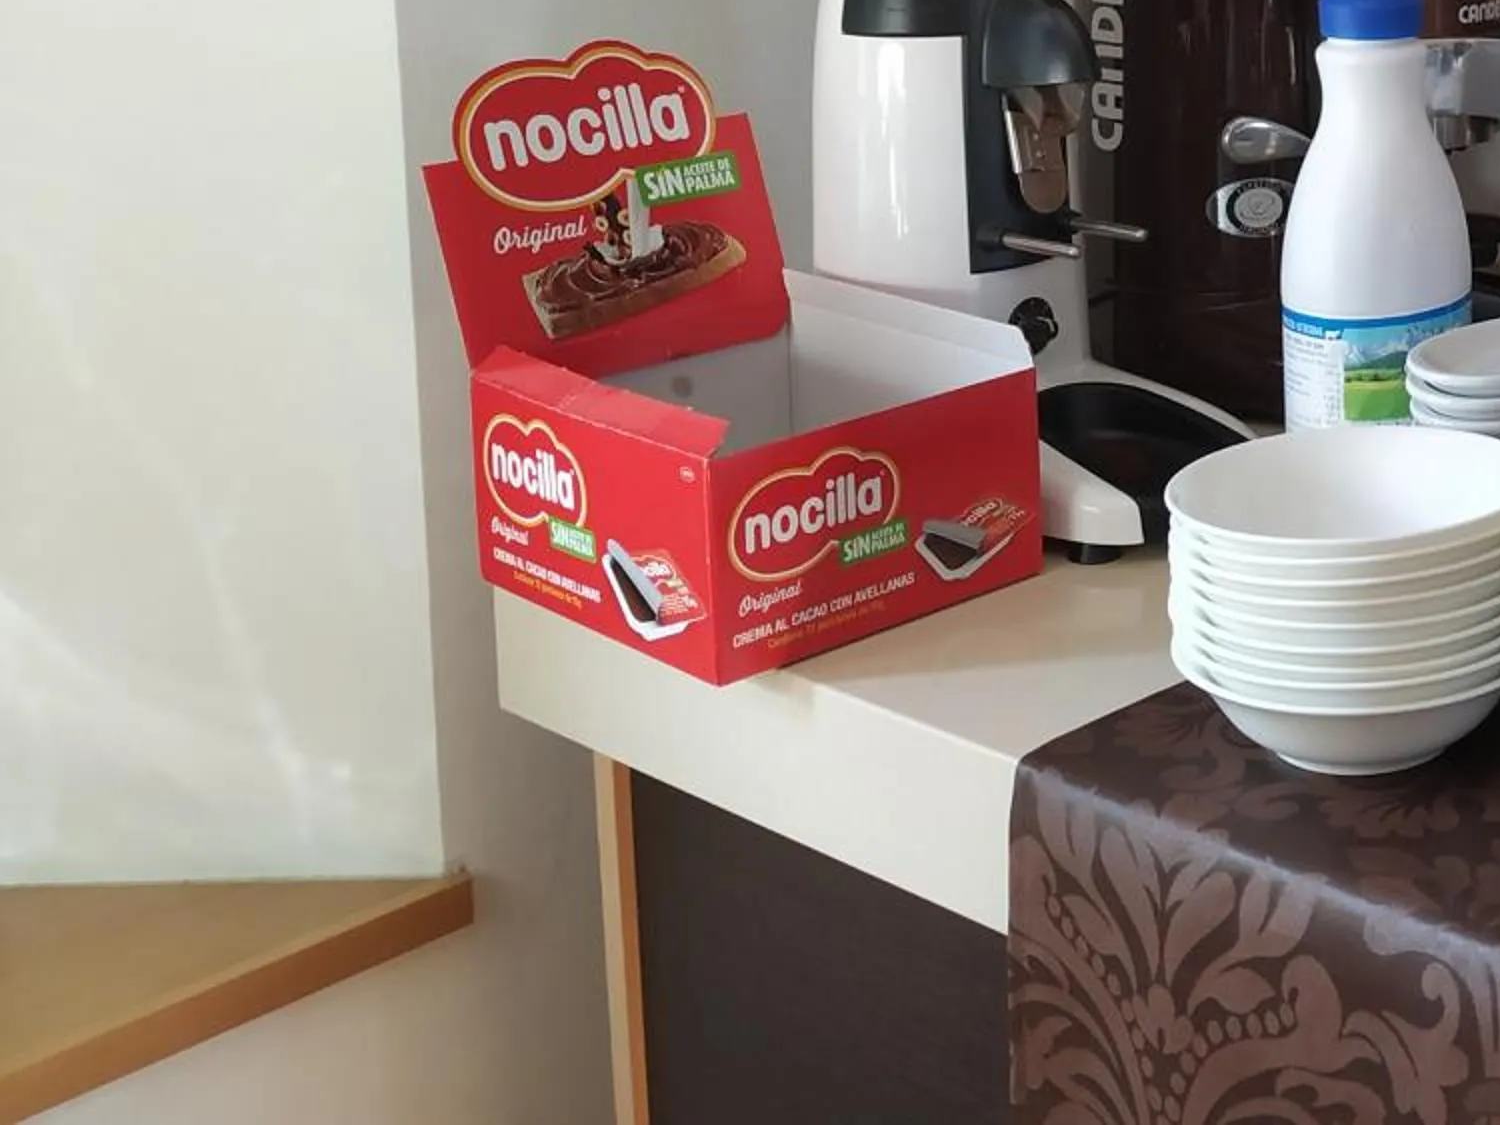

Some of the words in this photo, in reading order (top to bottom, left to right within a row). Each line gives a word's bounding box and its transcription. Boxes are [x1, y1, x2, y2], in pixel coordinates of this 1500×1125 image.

[482, 82, 690, 172] nocilla
[643, 167, 686, 200] SIN
[683, 161, 715, 177] ACEITE
[717, 157, 731, 171] DE
[685, 170, 735, 193] PALMA
[493, 215, 588, 254] Original
[491, 442, 576, 511] nocilla
[744, 472, 884, 555] nocilla
[843, 533, 871, 563] SIN
[732, 621, 773, 649] CREMA
[775, 617, 790, 633] AL
[791, 601, 828, 625] CACAO
[829, 592, 854, 613] CON
[853, 571, 915, 605] AVELLANAS
[738, 578, 804, 618] Original
